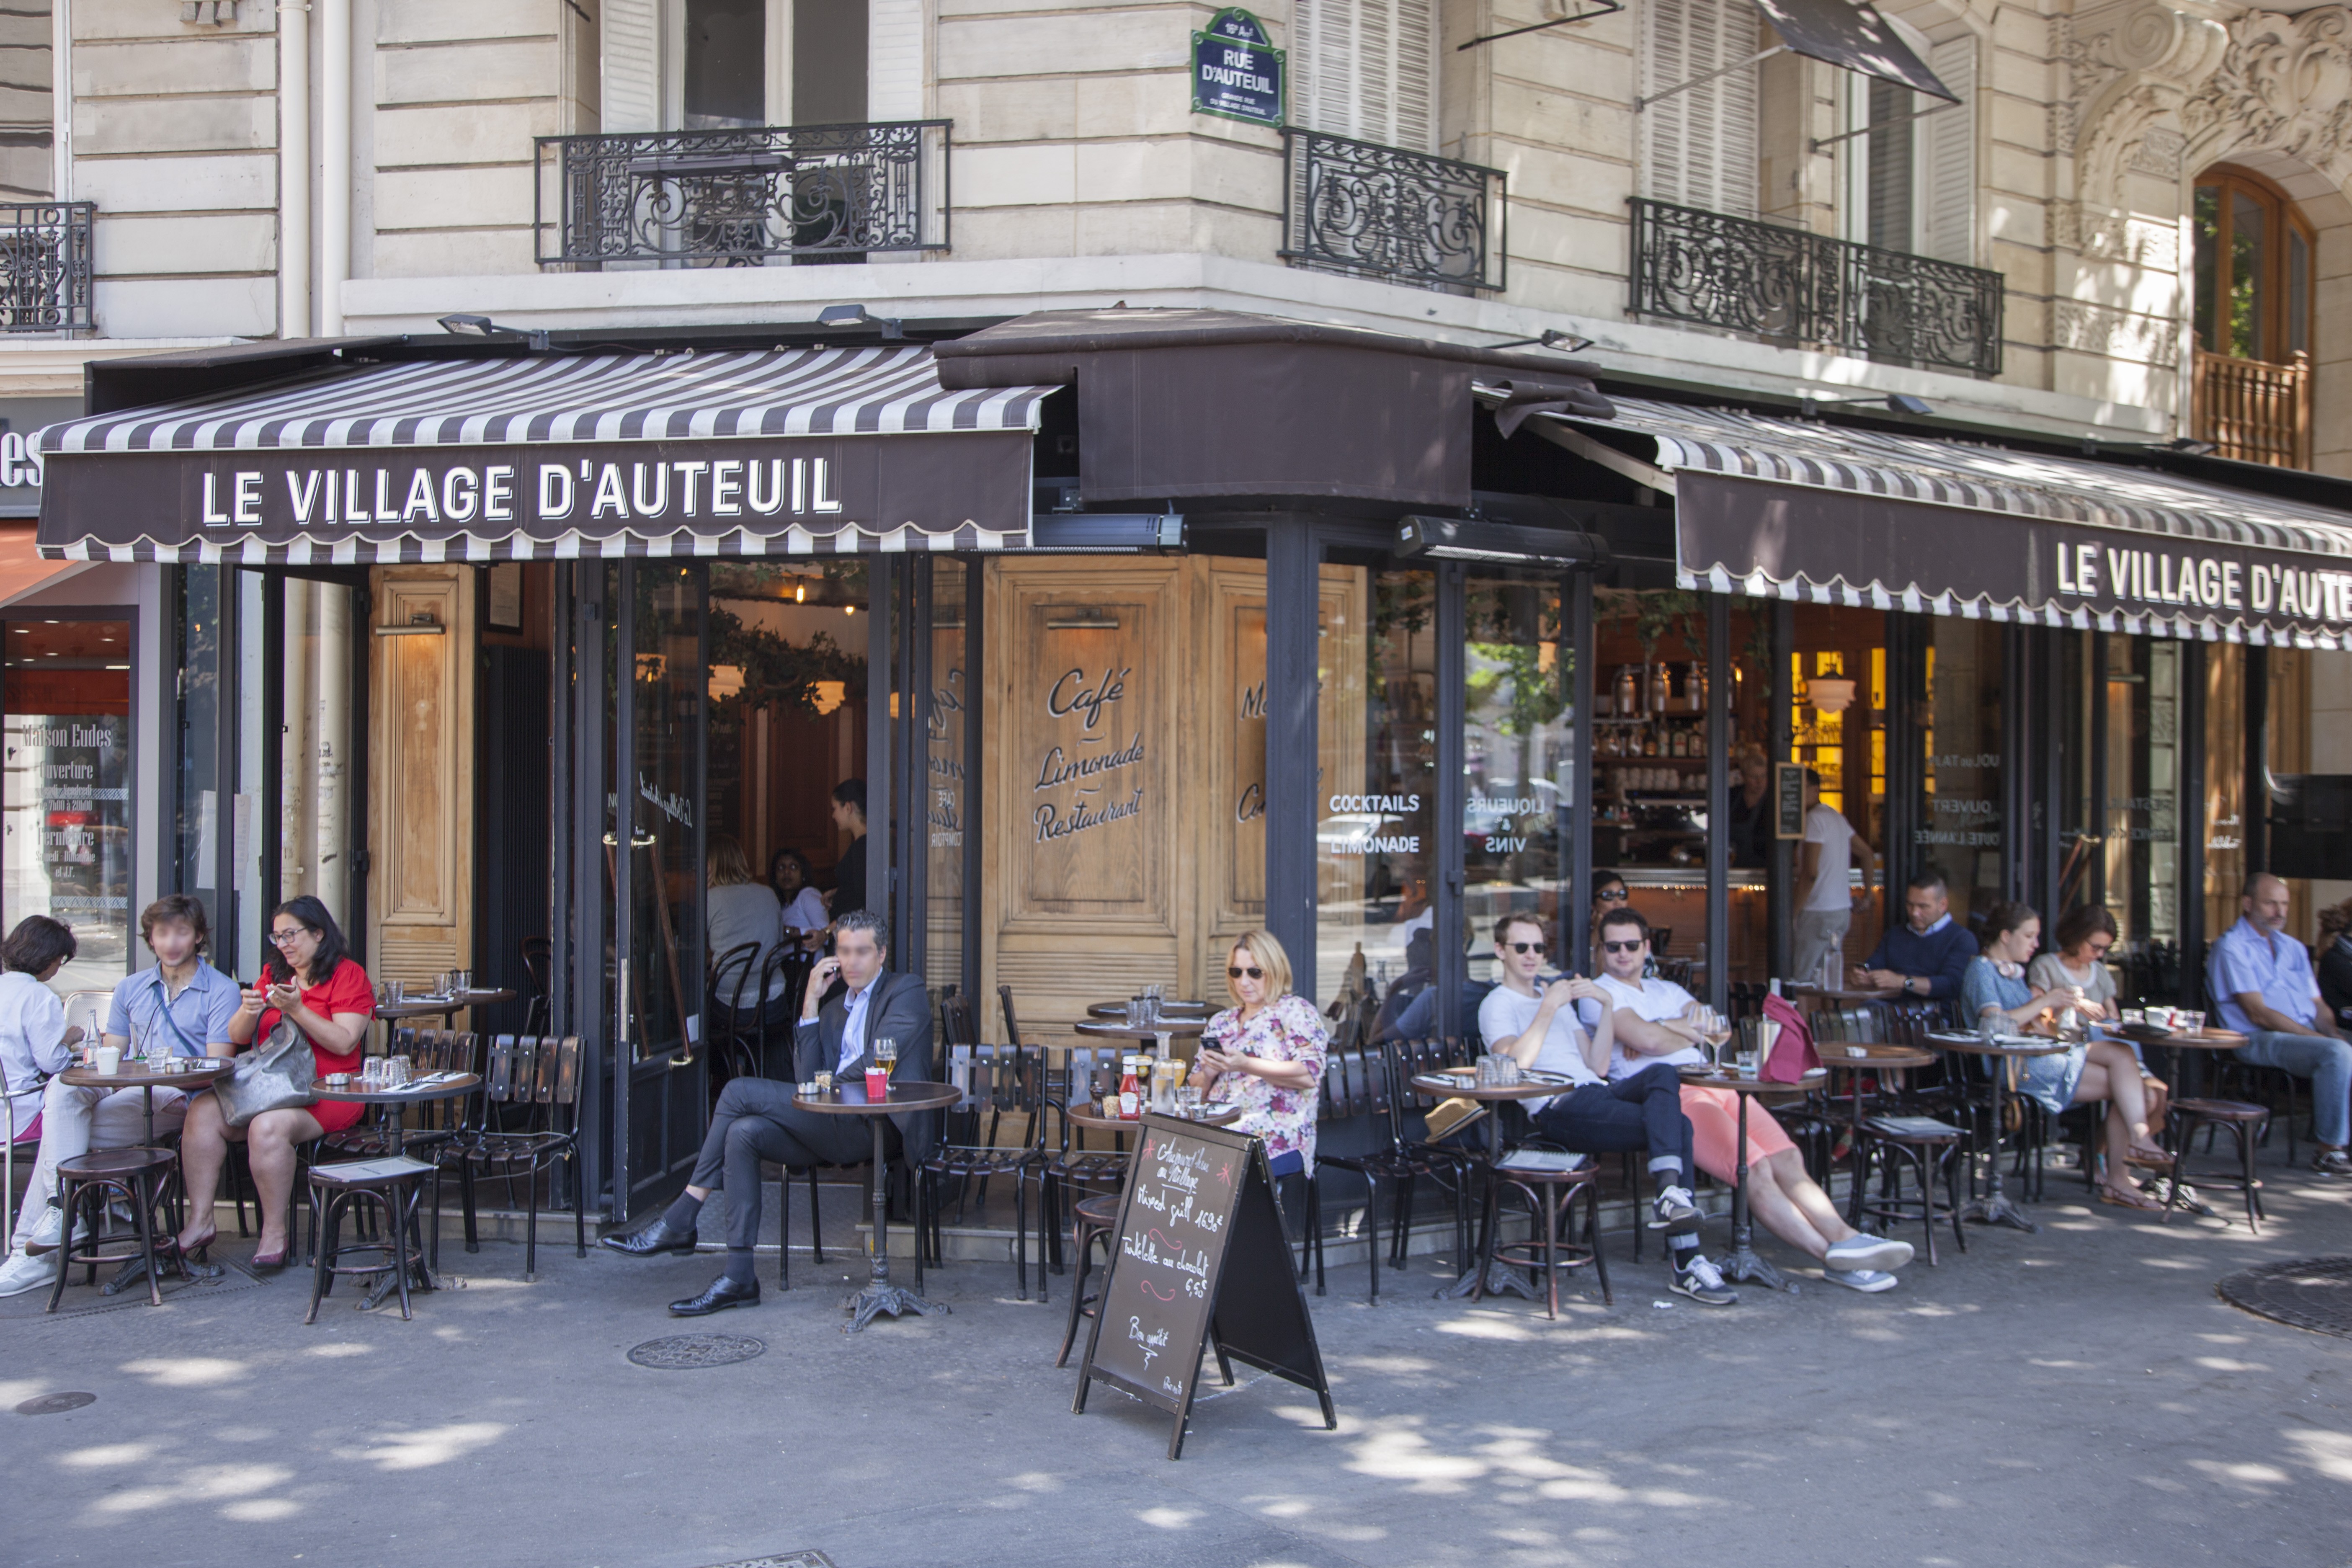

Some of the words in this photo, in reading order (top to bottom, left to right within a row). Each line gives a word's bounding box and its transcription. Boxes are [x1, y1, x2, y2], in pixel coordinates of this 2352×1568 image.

[1223, 49, 1254, 70] RUE
[1202, 64, 1274, 94] D'AUTEUIL
[203, 471, 264, 526] LE
[286, 465, 515, 524] VILLAGE
[539, 457, 842, 520] D'AUTEUIL
[2057, 542, 2098, 597] LE
[2107, 547, 2243, 610] VILLAGE
[1047, 668, 1132, 730] Café
[22, 724, 68, 747] Maison
[72, 724, 112, 747] Eudes
[40, 761, 93, 779] Ouverture
[1034, 732, 1144, 793] Limonade
[49, 799, 65, 811] 7h00
[72, 799, 93, 811] 20h00
[1034, 787, 1144, 843] Restaurant
[1329, 794, 1420, 812] COCKTAILS
[1331, 836, 1419, 854] LIMONADE
[1157, 1137, 1210, 1173] Aujourd'hui
[1137, 1184, 1166, 1212] Mixed
[1169, 1196, 1193, 1227] grill
[1660, 1199, 1675, 1218] N
[1122, 1231, 1159, 1264] Tartelette
[1163, 1258, 1174, 1268] au
[1176, 1249, 1209, 1279] chocolat
[1683, 1276, 1702, 1294] N
[1129, 1315, 1145, 1342] Bon
[1146, 1328, 1169, 1349] appétit
